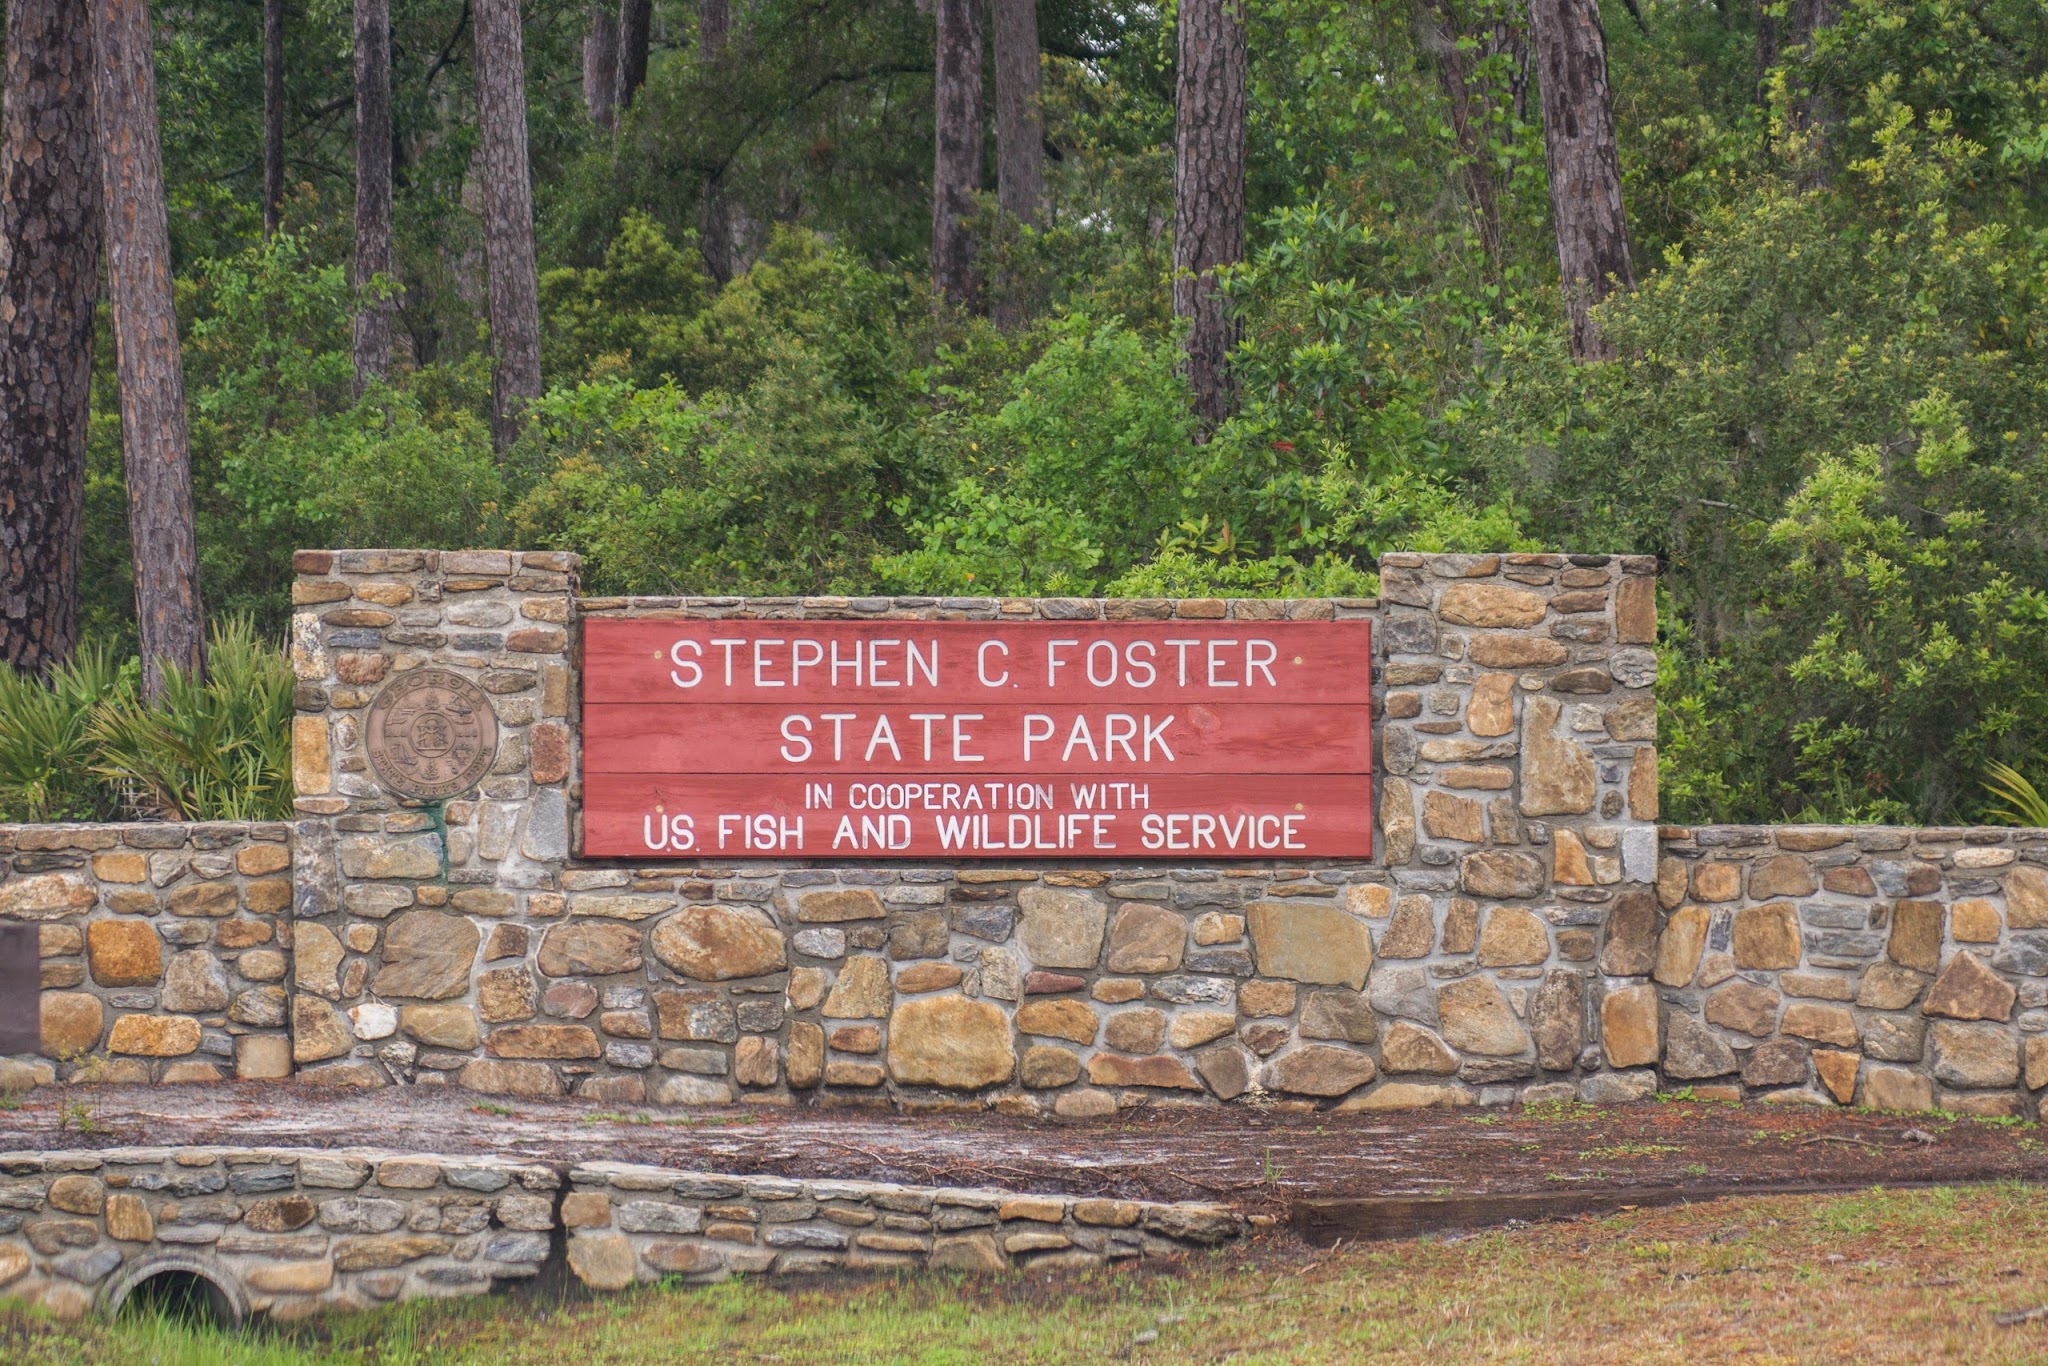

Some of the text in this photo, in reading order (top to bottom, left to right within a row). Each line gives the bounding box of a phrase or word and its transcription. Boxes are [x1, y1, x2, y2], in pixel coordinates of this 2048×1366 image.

[670, 639, 1278, 688] STEPHEN C. FOSTER
[377, 673, 486, 710] GEORGIA
[780, 713, 1175, 763] STATE PARK
[374, 749, 406, 787] STATE
[410, 781, 460, 796] PARKS
[805, 782, 1149, 810] IN COOPERATION WITH
[643, 813, 1307, 852] U.S. FISH AND WILDLIFE SERVICE
